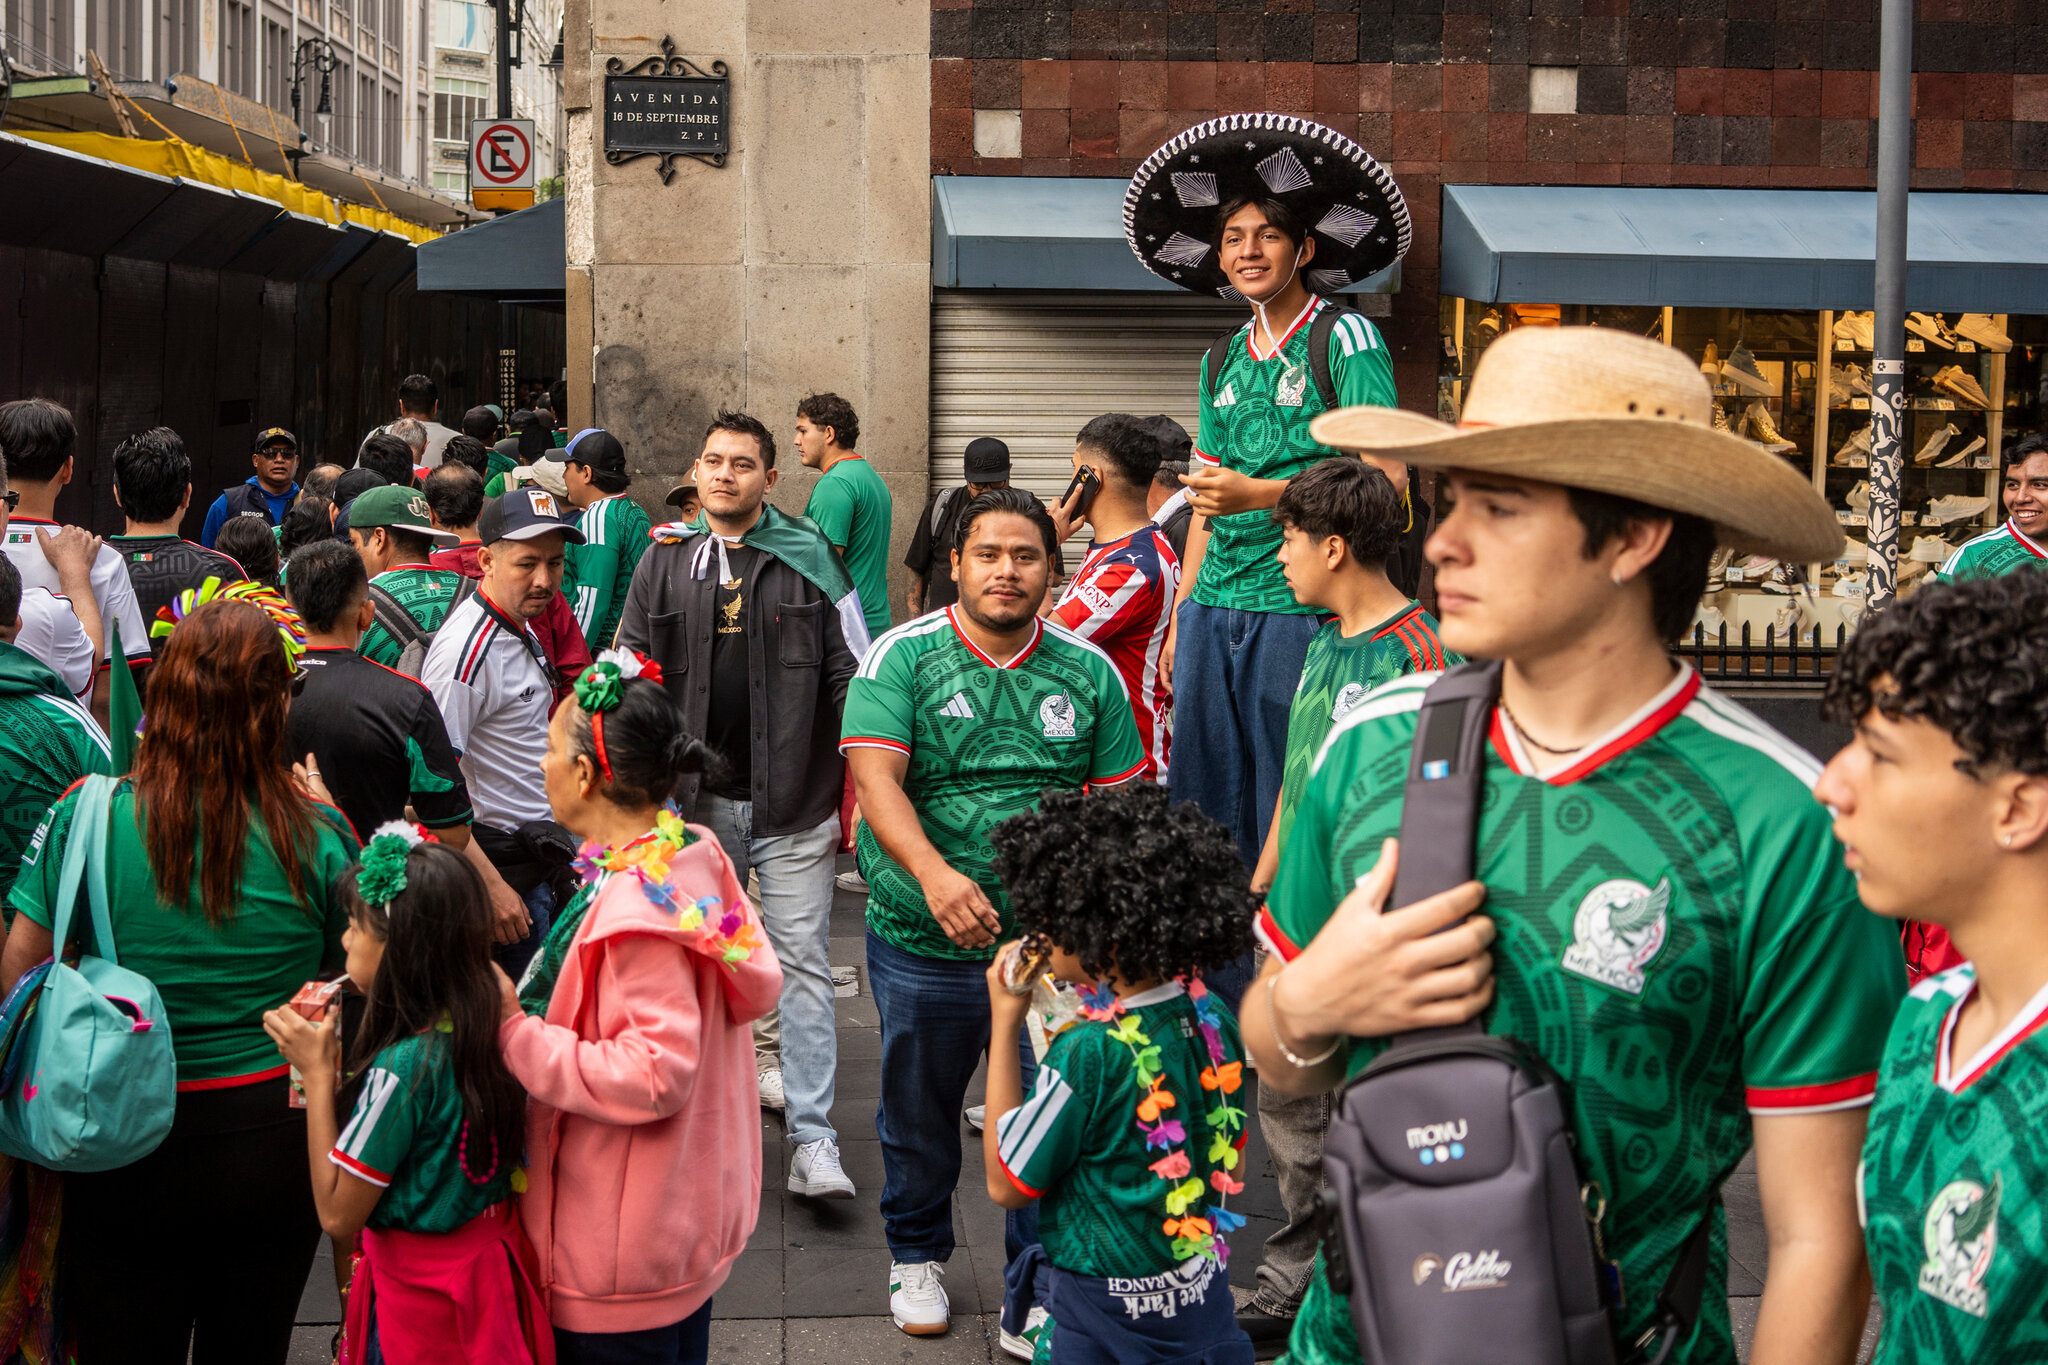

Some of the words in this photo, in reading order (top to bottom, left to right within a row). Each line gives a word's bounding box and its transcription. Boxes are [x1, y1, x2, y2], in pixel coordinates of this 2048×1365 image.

[613, 92, 719, 105] AVENIDA
[612, 111, 623, 122] 16
[627, 112, 643, 123] DE
[646, 112, 719, 125] SEPTIEMBRE
[681, 131, 691, 140] Z.
[697, 132, 705, 141] P.
[1084, 585, 1111, 608] GNP
[1107, 1274, 1167, 1293] RANCH
[1123, 1291, 1177, 1320] Park
